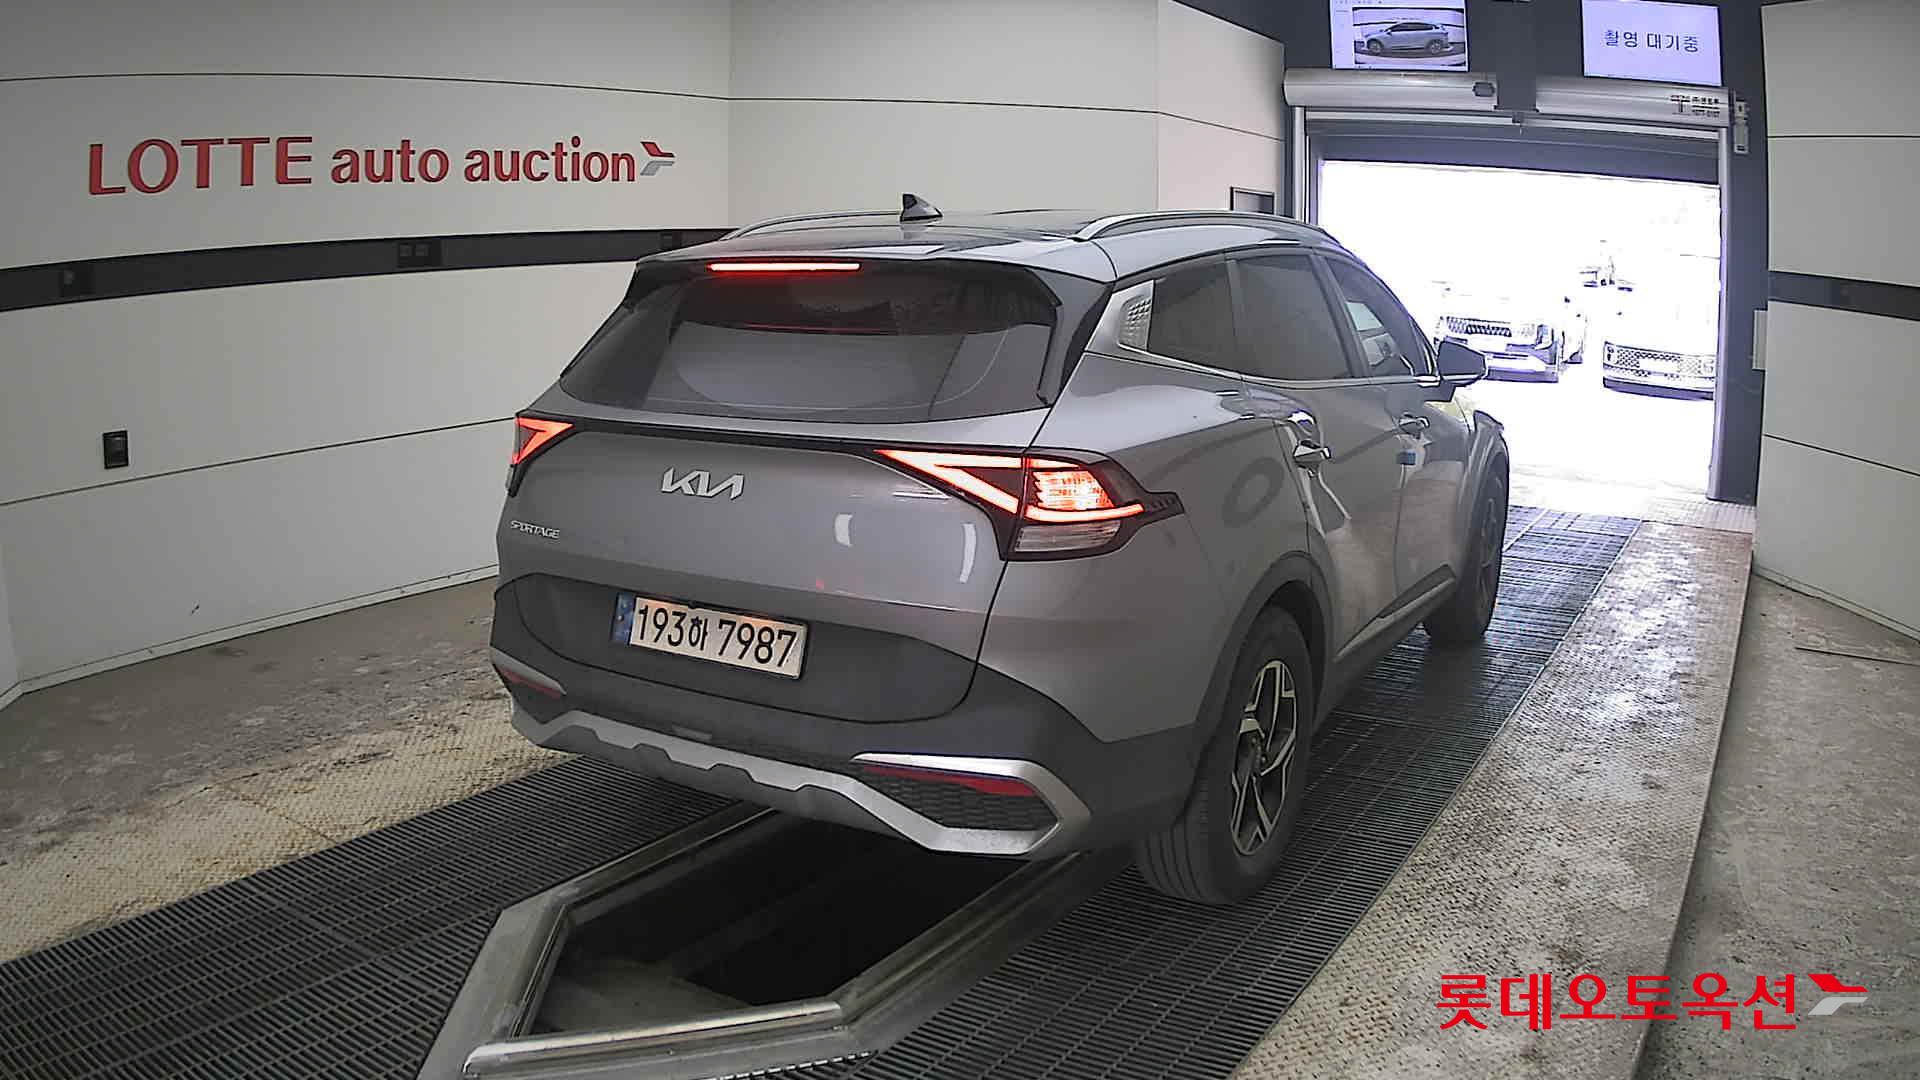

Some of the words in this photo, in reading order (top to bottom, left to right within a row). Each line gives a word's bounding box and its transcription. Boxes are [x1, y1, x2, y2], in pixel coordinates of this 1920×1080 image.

[1604, 29, 1638, 48] 촬영
[1647, 32, 1698, 53] 대기중
[88, 136, 313, 195] LOTTE
[330, 139, 450, 184] auto
[463, 136, 637, 184] auction
[661, 467, 745, 501] KIA
[510, 520, 560, 539] SPORTAGE
[638, 604, 709, 652] 193하
[718, 618, 798, 668] 7987
